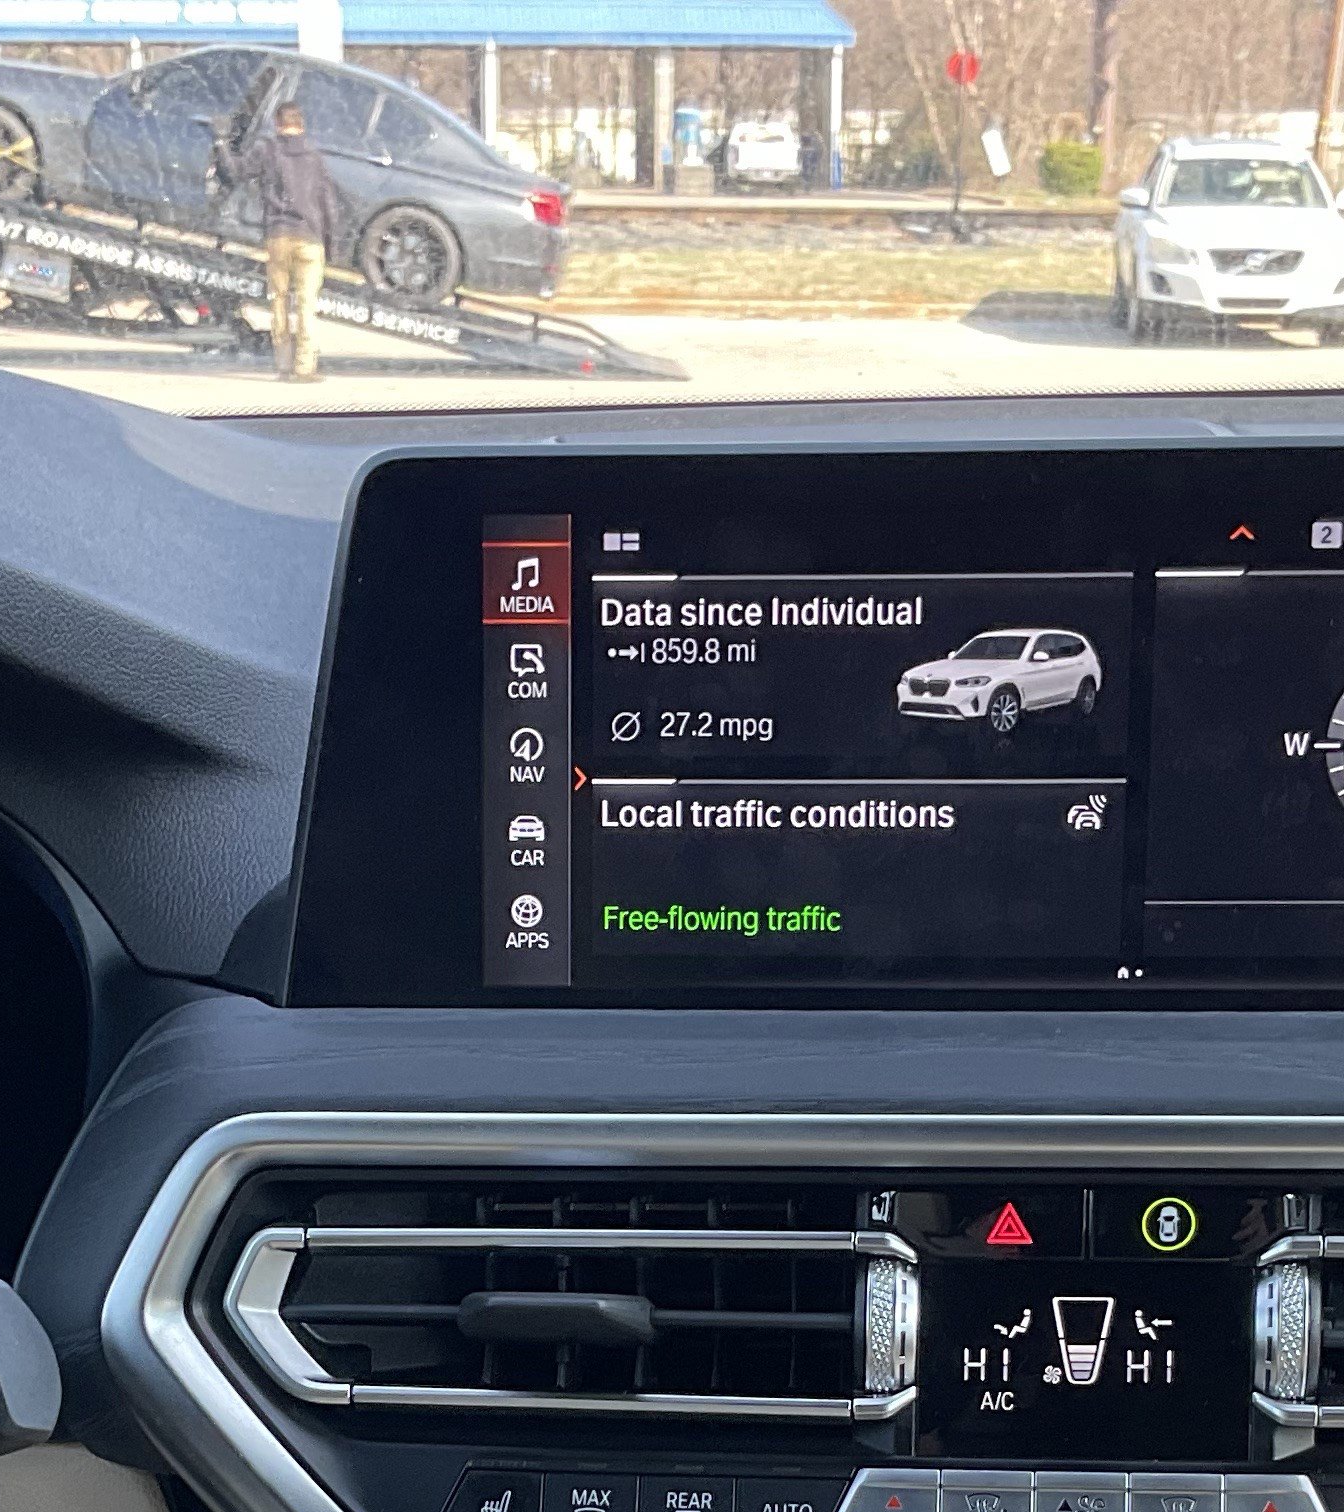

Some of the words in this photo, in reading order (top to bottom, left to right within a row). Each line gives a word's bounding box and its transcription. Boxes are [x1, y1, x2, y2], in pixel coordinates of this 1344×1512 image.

[26, 227, 134, 267] ROADSIDE
[135, 253, 265, 298] ASSISTANCE
[371, 310, 460, 344] SERVICE
[499, 596, 554, 614] MEDIA
[600, 598, 672, 628] Data
[680, 597, 762, 627] since
[771, 596, 923, 627] Individual
[651, 638, 721, 665] 859.8
[727, 637, 757, 664] mi
[507, 681, 548, 699] COM
[659, 711, 713, 739] 27.2
[719, 715, 774, 743] mpg
[1284, 733, 1310, 756] W
[509, 766, 545, 784] NAV
[600, 800, 682, 829] Local
[690, 799, 781, 829] traffic
[789, 800, 955, 830] conditions
[510, 849, 545, 867] CAR
[602, 905, 760, 937] Free-flowing
[766, 906, 842, 933] traffic
[505, 931, 550, 950] APPS
[963, 1347, 1011, 1383] HI
[1126, 1349, 1174, 1384] HI
[980, 1391, 1015, 1413] A/C
[571, 1489, 612, 1508] MAX
[665, 1491, 713, 1510] REAR
